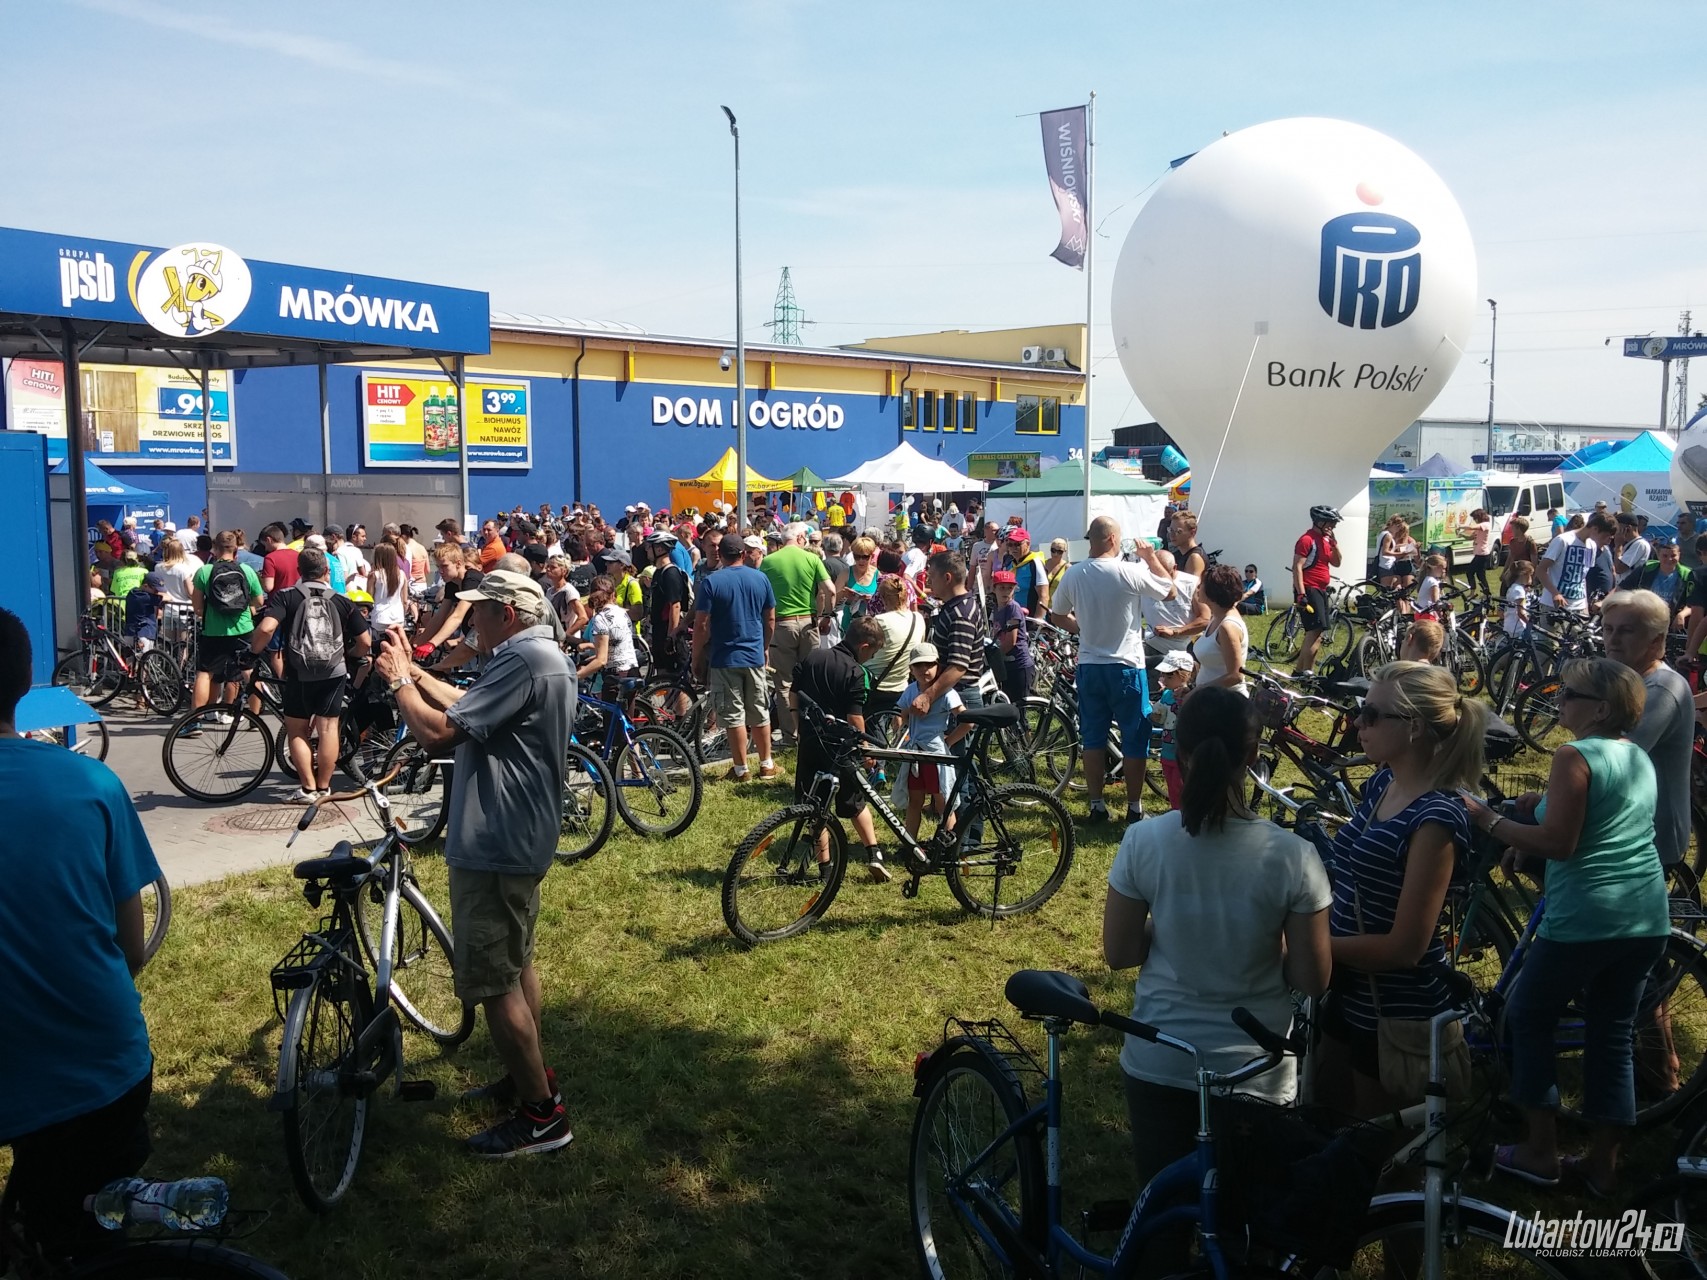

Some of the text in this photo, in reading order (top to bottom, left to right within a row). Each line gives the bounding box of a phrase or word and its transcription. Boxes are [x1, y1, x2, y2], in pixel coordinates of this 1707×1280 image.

[59, 248, 90, 259] GRUPA
[60, 252, 116, 308] psb
[279, 284, 440, 334] MRÓWKA
[32, 368, 55, 382] HIT!
[1267, 361, 1428, 393] Bank Polski
[23, 378, 60, 394] cenowy
[377, 385, 402, 399] HIT
[652, 395, 723, 426] DOM
[748, 396, 845, 429] OGRÓD
[483, 417, 521, 425] BIOHUMUS
[152, 430, 195, 438] DRZWIOWE
[493, 426, 521, 434] NAWÓZ
[131, 510, 155, 518] Allianz
[862, 783, 906, 837] MERIDA
